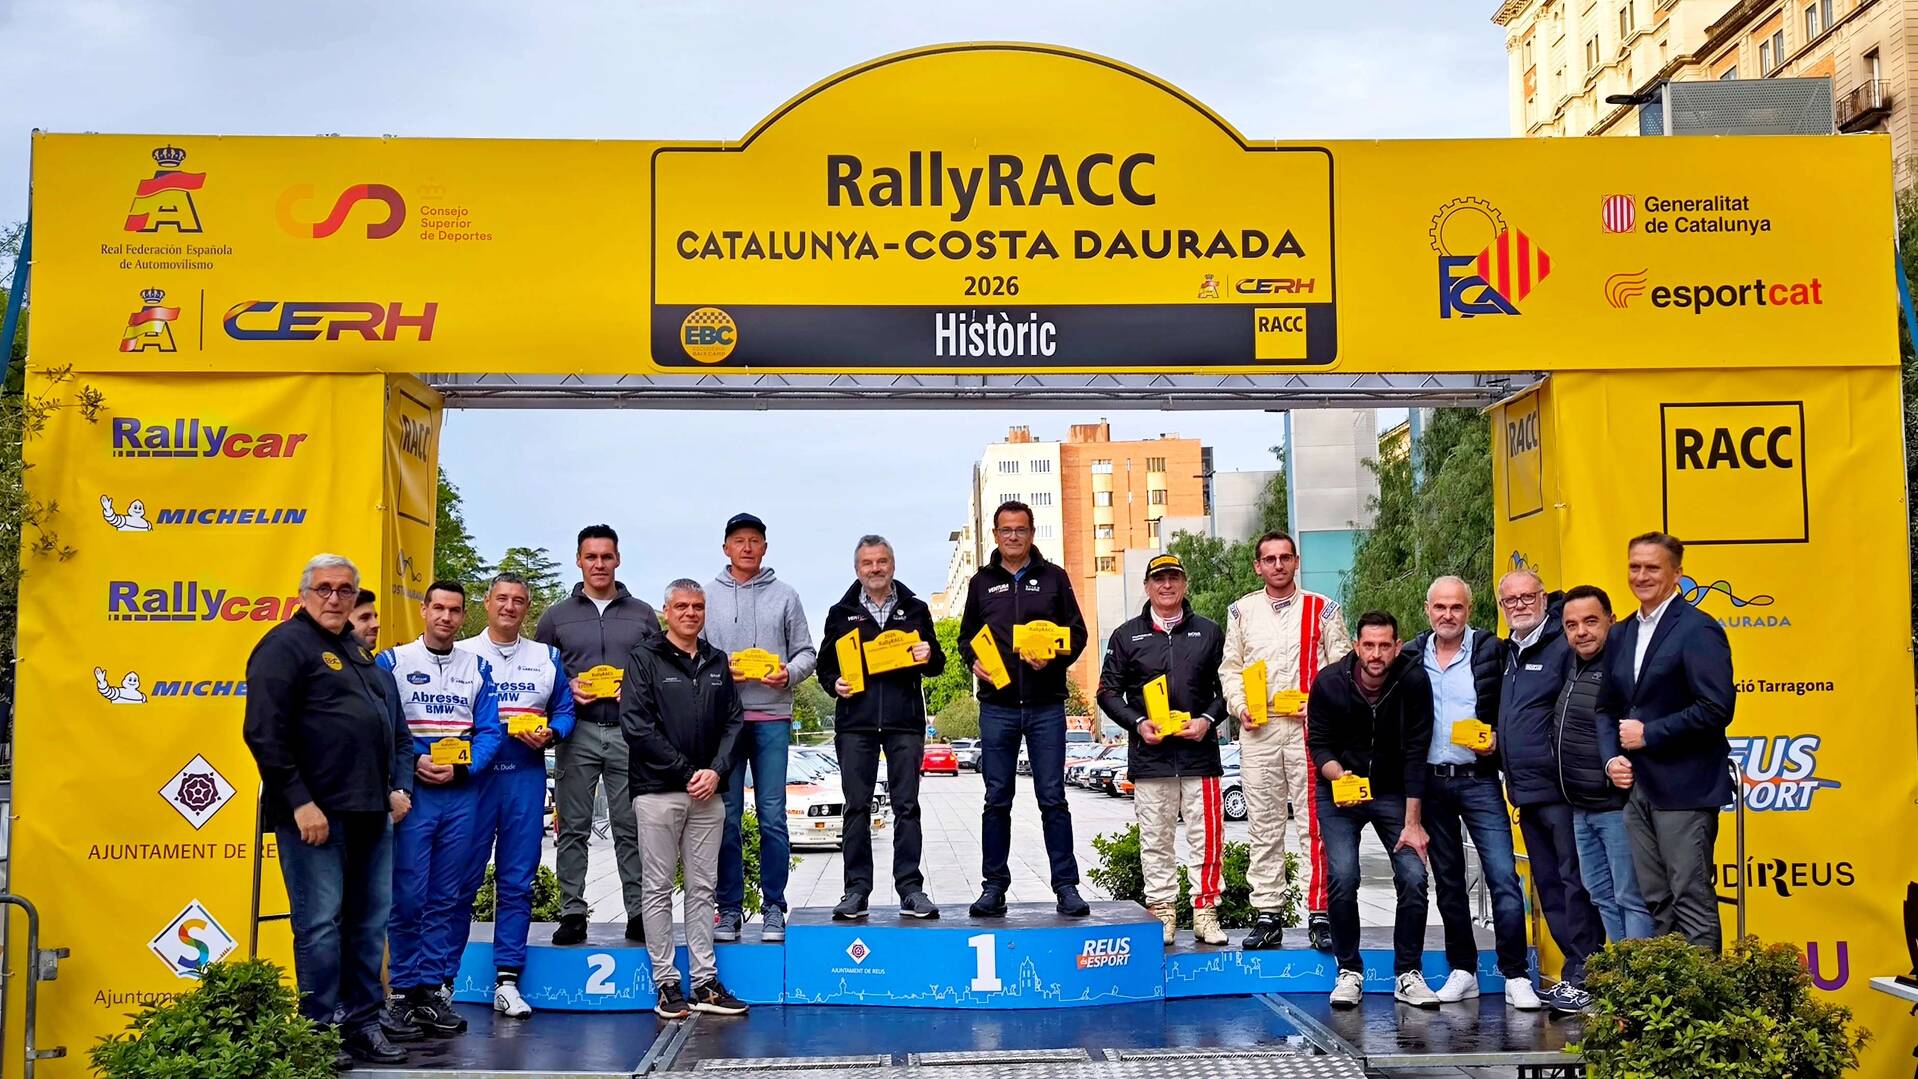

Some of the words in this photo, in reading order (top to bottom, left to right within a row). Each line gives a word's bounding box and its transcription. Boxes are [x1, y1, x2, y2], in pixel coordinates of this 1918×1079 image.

[827, 150, 1156, 222] RallyRACC
[420, 205, 469, 218] Consejo
[1644, 195, 1749, 212] Generalitat
[421, 218, 472, 231] Superior
[1645, 217, 1668, 233] de
[1674, 216, 1771, 236] Catalunya
[420, 230, 435, 241] de
[438, 230, 493, 242] Deportes
[1073, 228, 1306, 260] DAURADA
[101, 243, 122, 255] Real
[126, 243, 182, 255] Federación
[186, 243, 233, 257] Española
[119, 259, 132, 269] de
[135, 259, 214, 270] Automovilismo
[964, 275, 1019, 296] 2026
[1235, 278, 1315, 294] CERH
[1651, 278, 1823, 315] esportcat
[223, 301, 439, 341] CERH
[1258, 315, 1303, 332] RACC
[685, 325, 735, 346] EBC
[935, 311, 1056, 357] Històric
[112, 417, 308, 458] Rallycar
[401, 414, 431, 463] RACC
[1508, 410, 1538, 458] RACC
[1674, 426, 1793, 470] RACC
[156, 508, 308, 525] MICHELIN
[850, 636, 858, 650] 1
[982, 633, 992, 646] 1
[1055, 638, 1064, 648] 1
[764, 663, 775, 678] 2
[1156, 682, 1165, 695] 1
[1758, 679, 1834, 696] Tarragona
[412, 691, 468, 705] Abressa
[425, 704, 455, 714] BMW
[1478, 732, 1487, 744] 5
[458, 749, 468, 761] 4
[1360, 786, 1368, 798] 5
[88, 843, 217, 860] AJUNTAMENT
[224, 843, 247, 859] DE
[1083, 936, 1131, 956] REUS
[968, 933, 1002, 992] 1
[1087, 954, 1131, 968] ESPORT
[585, 953, 616, 995] 2
